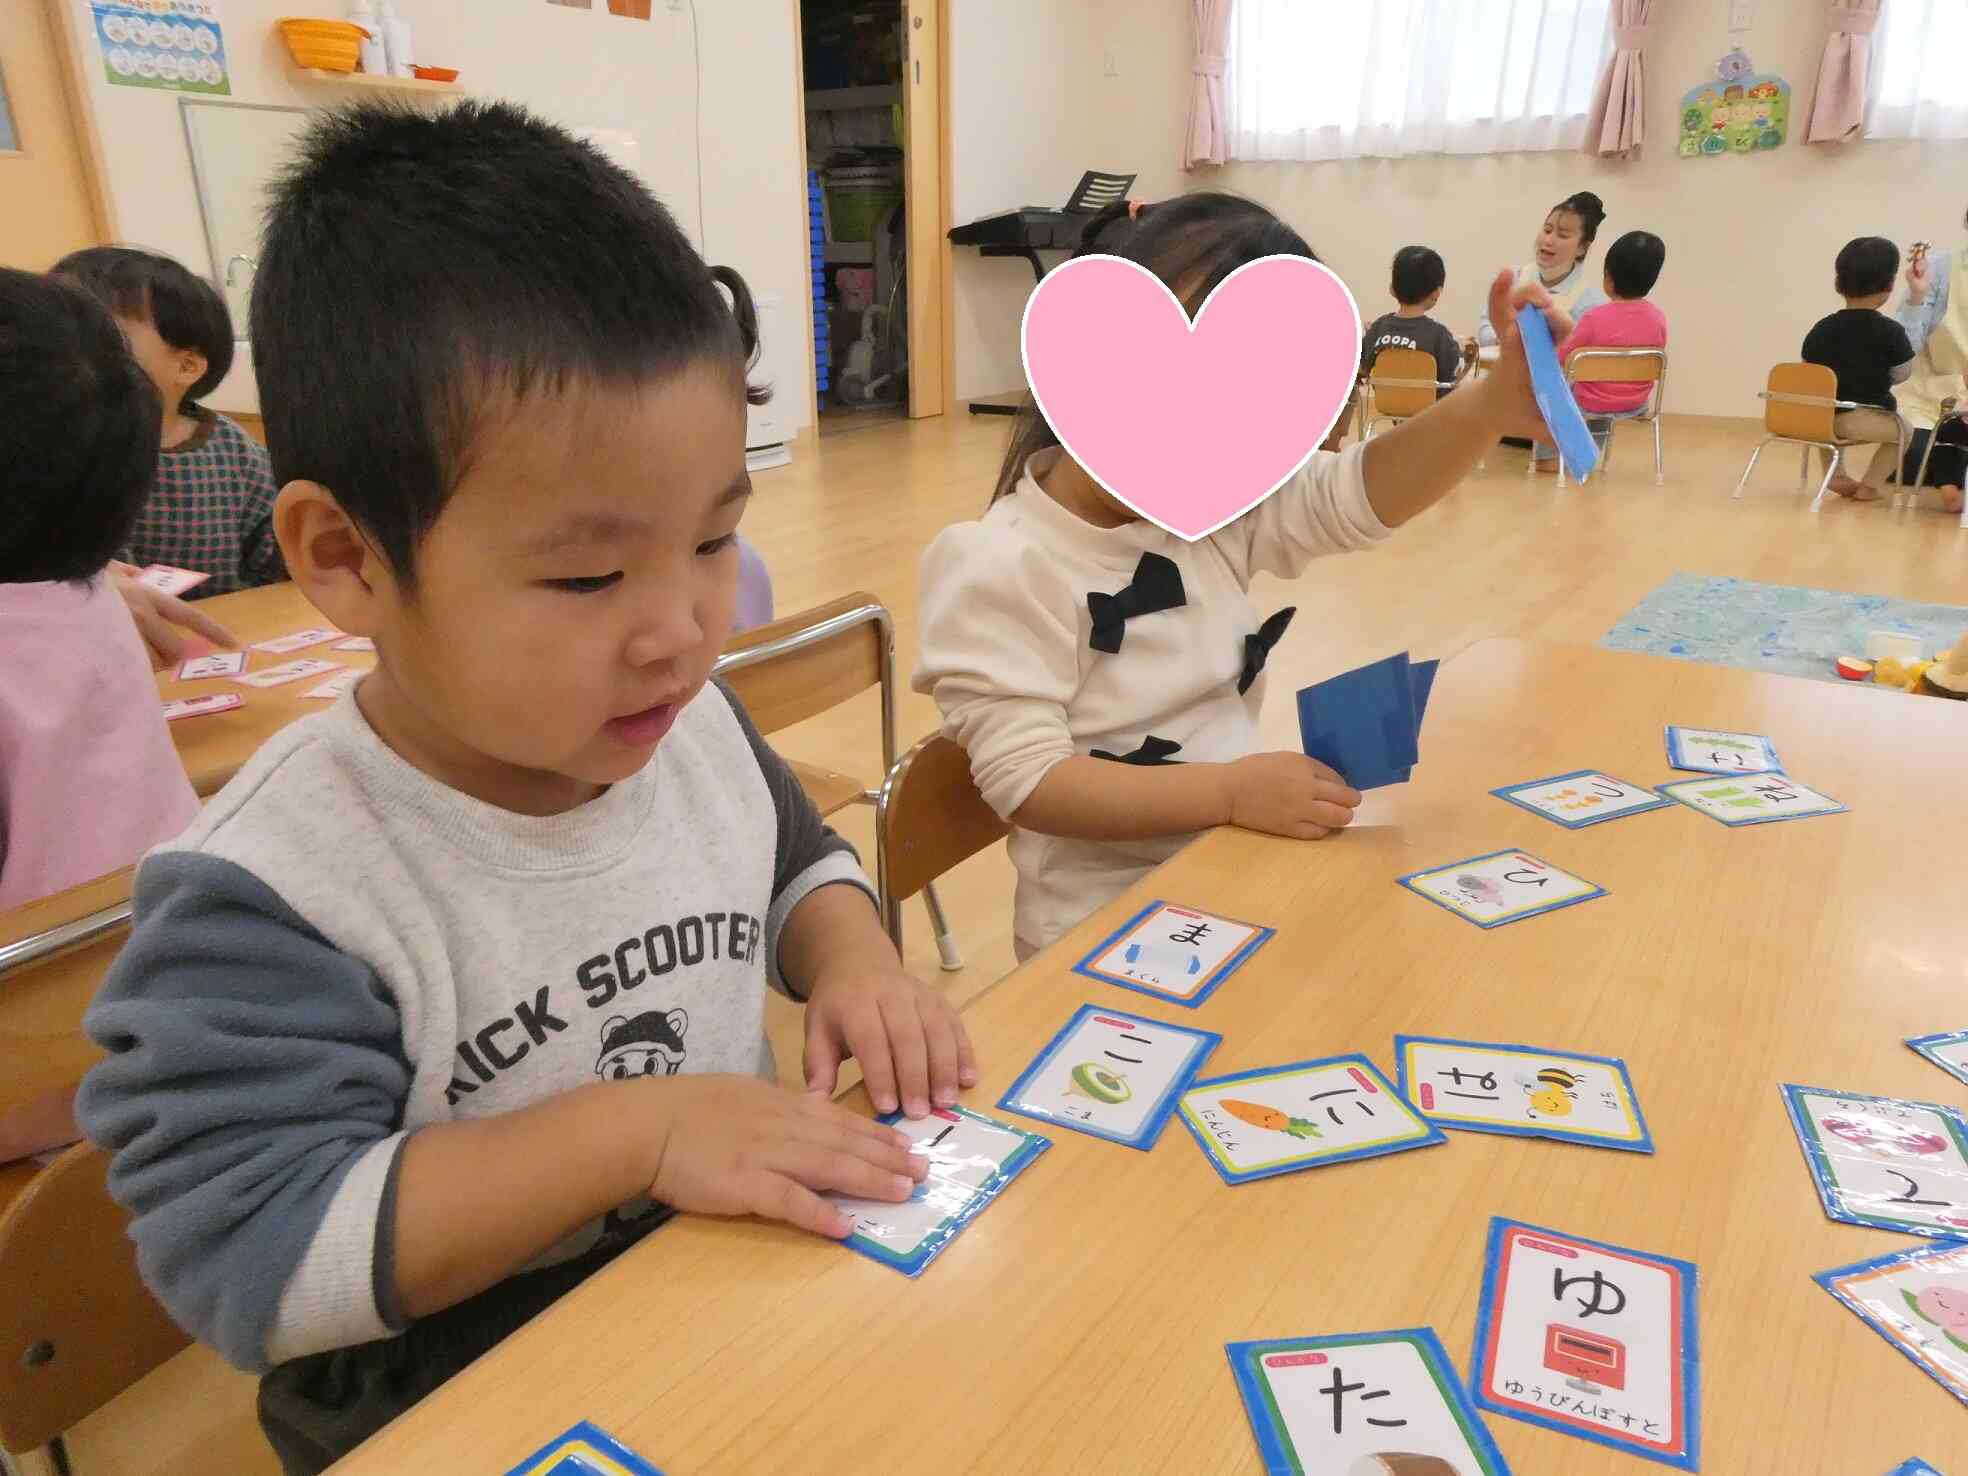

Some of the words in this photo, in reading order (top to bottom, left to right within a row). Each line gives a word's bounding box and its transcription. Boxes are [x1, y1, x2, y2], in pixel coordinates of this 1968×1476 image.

[1752, 784, 1799, 803] ね
[1503, 868, 1549, 888] ひ
[1169, 923, 1212, 946] ま
[576, 912, 760, 1008] SCOOTER
[1104, 1033, 1152, 1063] こ
[1437, 1067, 1500, 1100] は
[1309, 1088, 1375, 1125] に
[1201, 1108, 1241, 1152] にんじん
[1886, 1168, 1953, 1206] て
[1553, 1267, 1626, 1318] ゆ
[1319, 1367, 1408, 1434] た
